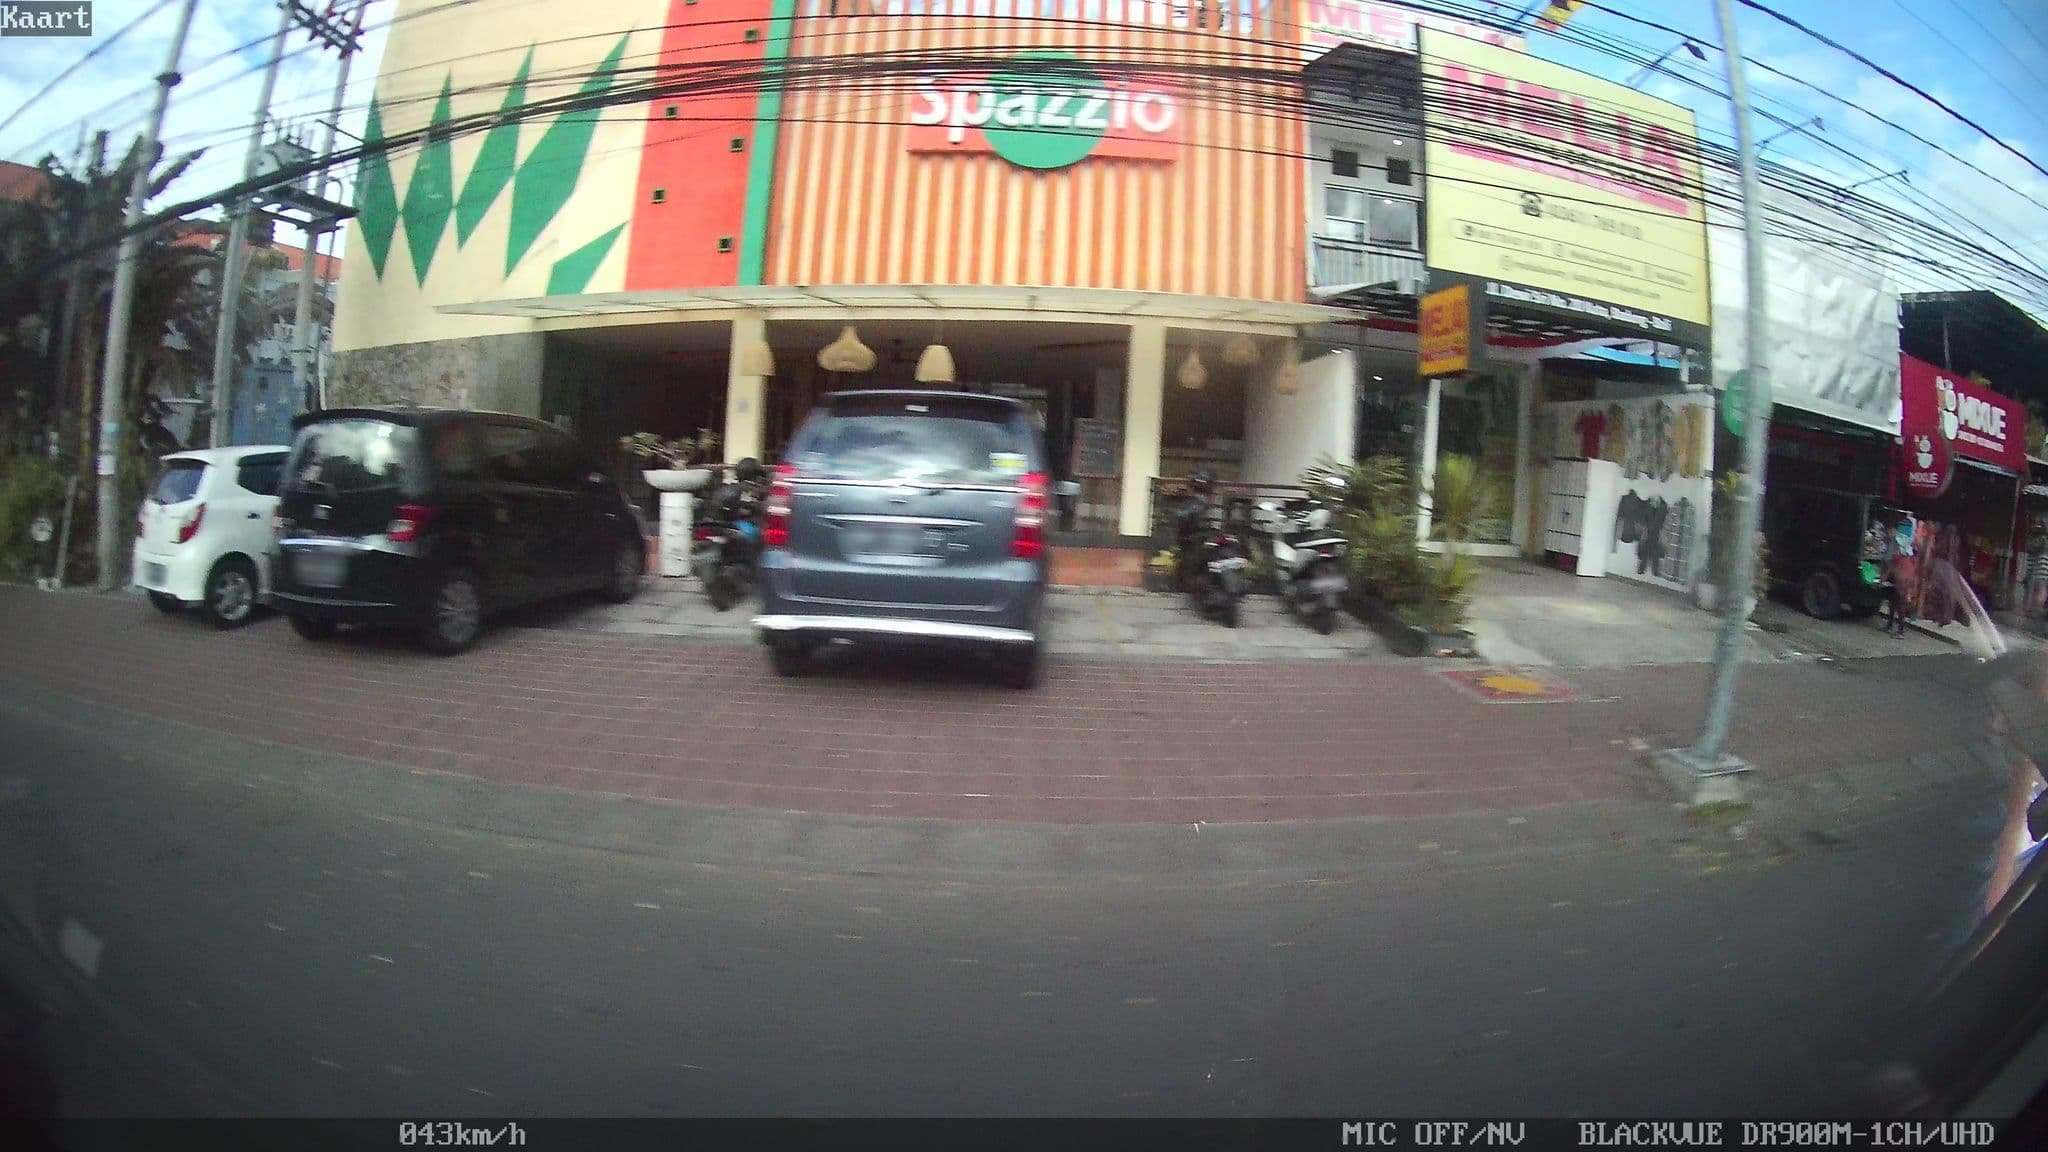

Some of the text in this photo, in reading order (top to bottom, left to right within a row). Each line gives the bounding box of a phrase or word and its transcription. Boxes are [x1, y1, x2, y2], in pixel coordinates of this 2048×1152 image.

[911, 76, 1176, 143] Spazzio
[1443, 62, 1685, 181] MELIA
[1958, 392, 2006, 440] MIXUE
